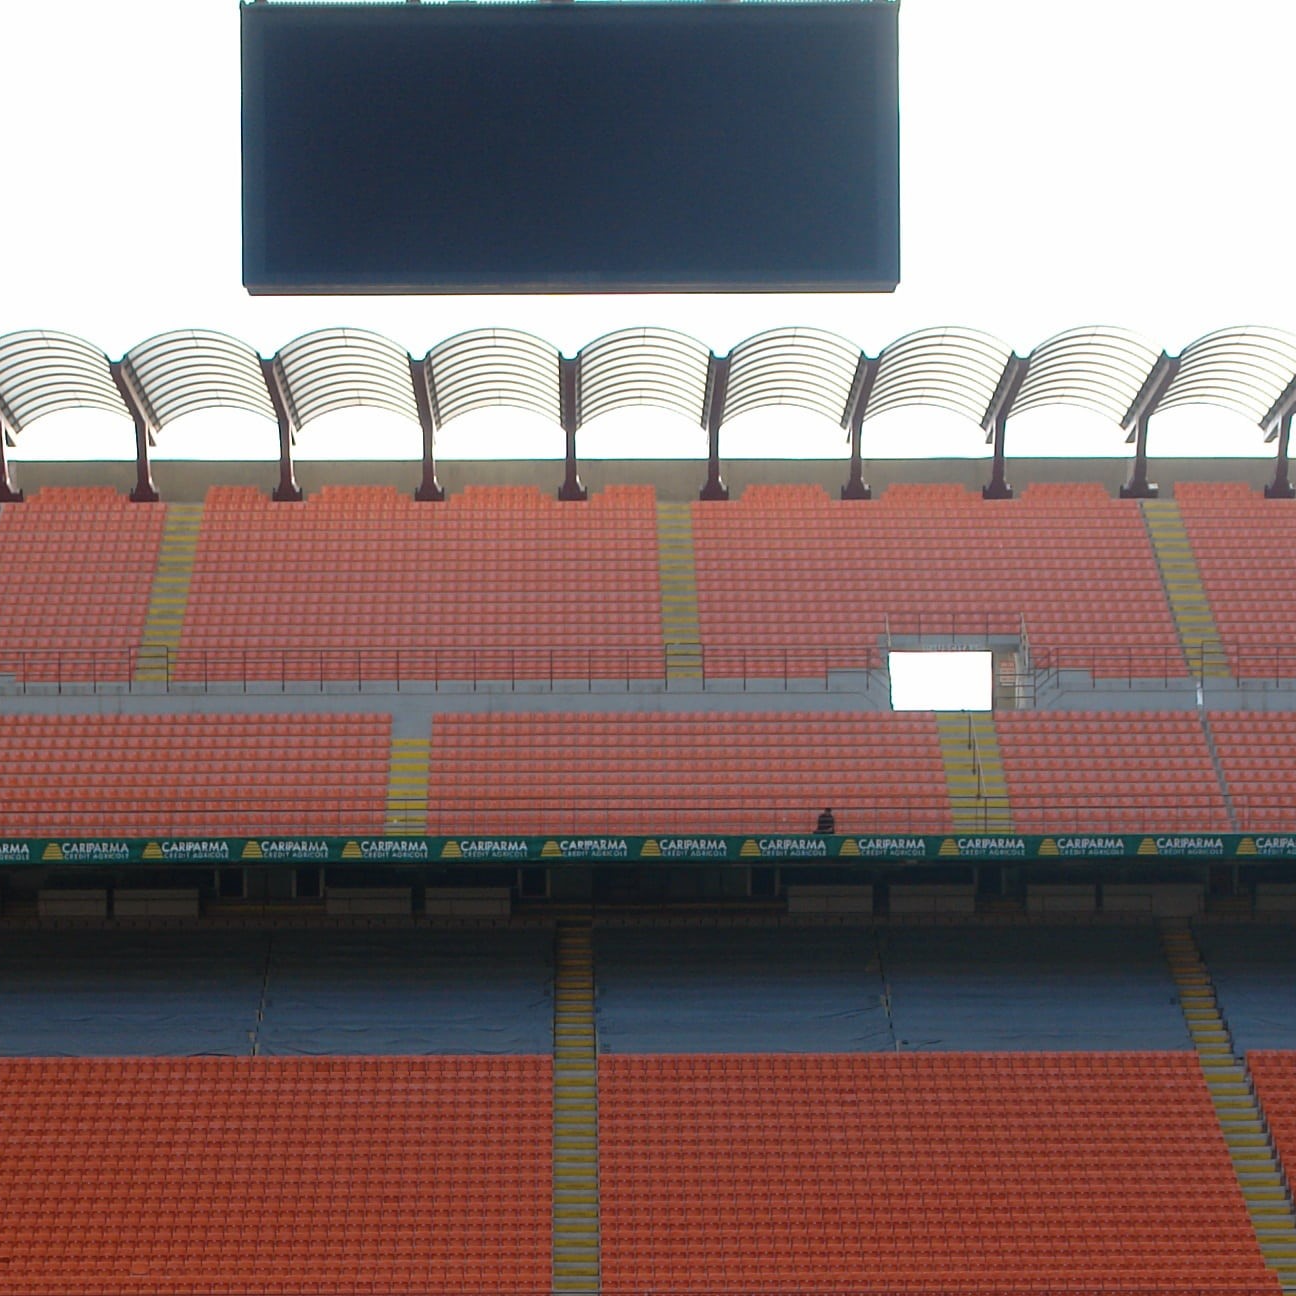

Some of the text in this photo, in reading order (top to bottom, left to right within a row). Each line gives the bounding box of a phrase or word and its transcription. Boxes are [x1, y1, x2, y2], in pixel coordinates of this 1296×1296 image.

[62, 843, 129, 853] CARIPARMA
[162, 842, 229, 852] CARIPARMA
[261, 841, 328, 852] CARIPARMA
[361, 841, 428, 851] CARIPARMA
[461, 841, 528, 851] CARIPARMA
[560, 840, 627, 850] CARIPARMA
[660, 840, 727, 850] CARIPARMA
[759, 840, 826, 850] CARIPARMA
[859, 839, 925, 849] CARIPARMA
[958, 839, 1025, 849] CARIPARMA
[1058, 839, 1124, 848] CARIPARMA
[1157, 838, 1223, 848] CARIPARMA
